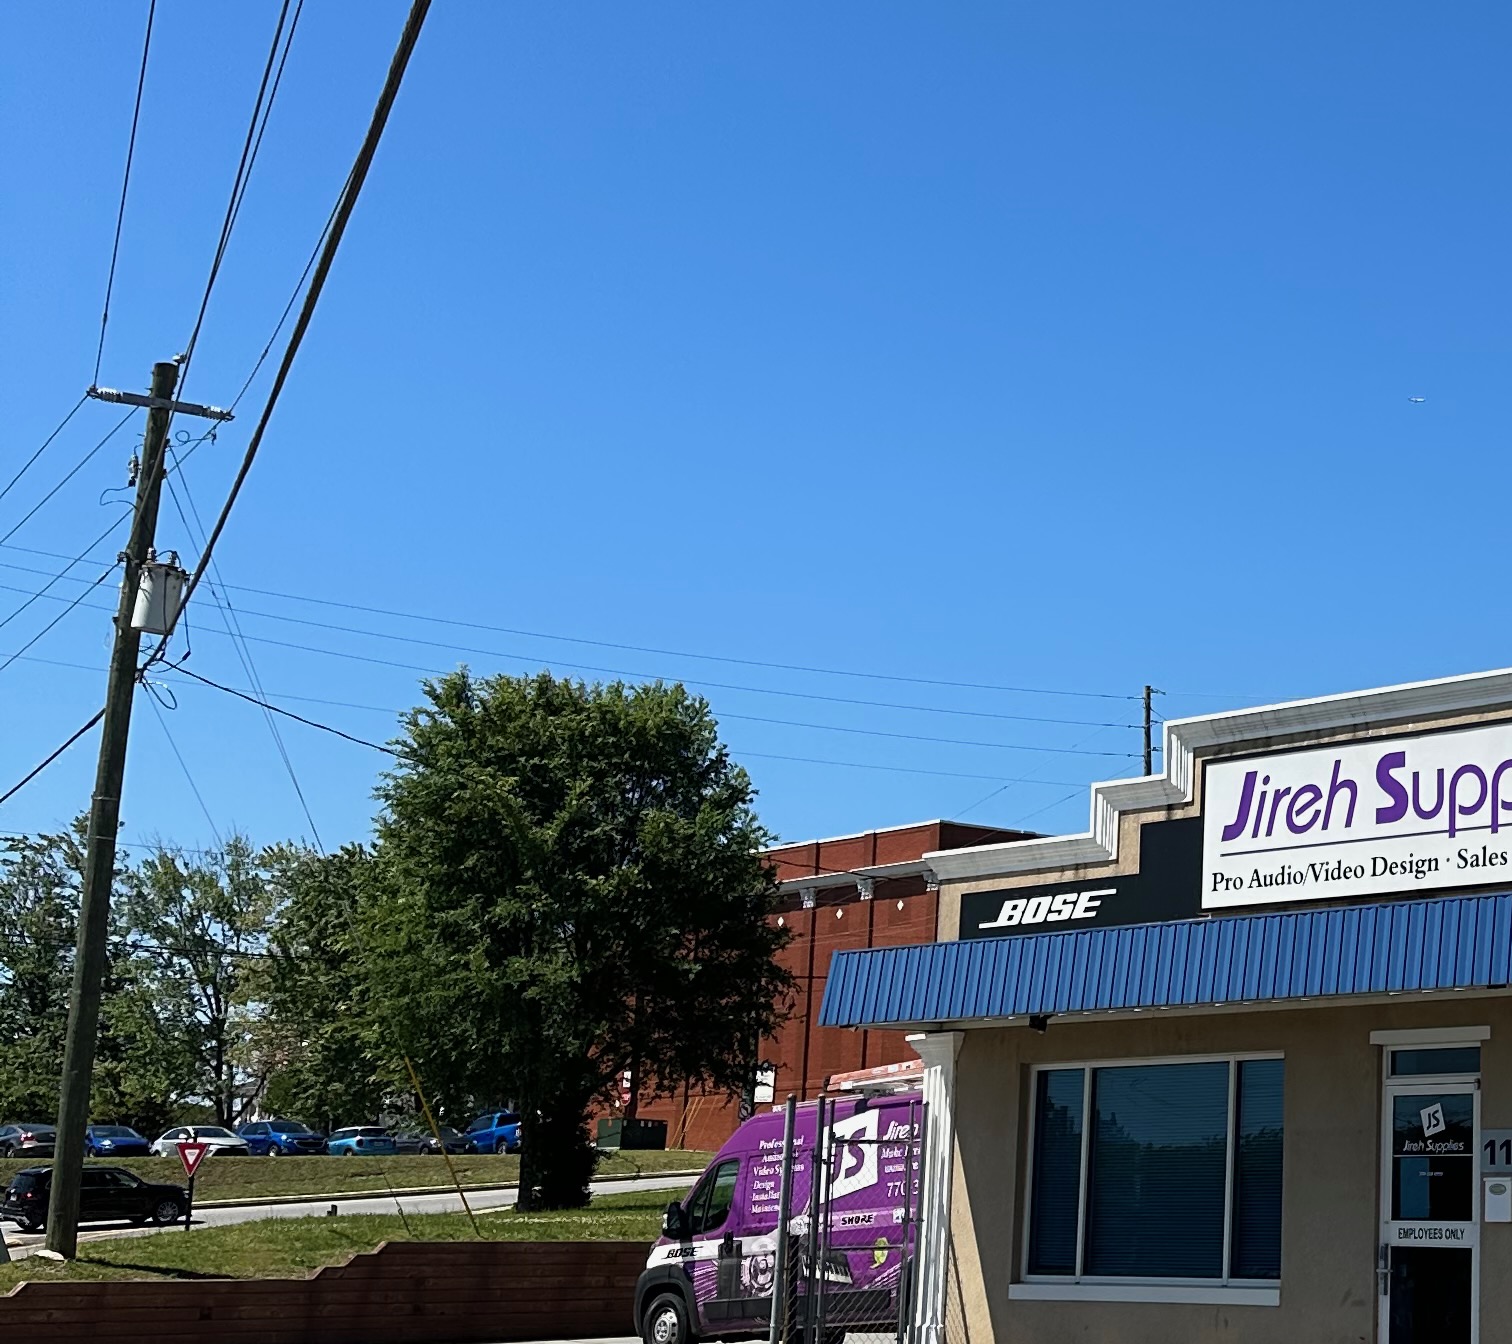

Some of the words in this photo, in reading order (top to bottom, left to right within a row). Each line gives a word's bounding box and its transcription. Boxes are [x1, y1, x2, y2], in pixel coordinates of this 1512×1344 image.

[1221, 760, 1358, 842] Jireh
[1211, 872, 1244, 892] Pro
[1248, 859, 1365, 888] Audio/Video
[1371, 852, 1440, 880] Design
[1457, 845, 1508, 870] Sales
[978, 888, 1117, 929] BOSE
[1426, 1109, 1440, 1131] JS
[1402, 1139, 1425, 1152] Jireh
[1425, 1138, 1465, 1154] Supplies
[1398, 1227, 1443, 1240] EMPLOYEES
[1444, 1227, 1465, 1240] ONLY
[661, 1245, 703, 1260] BOSE
